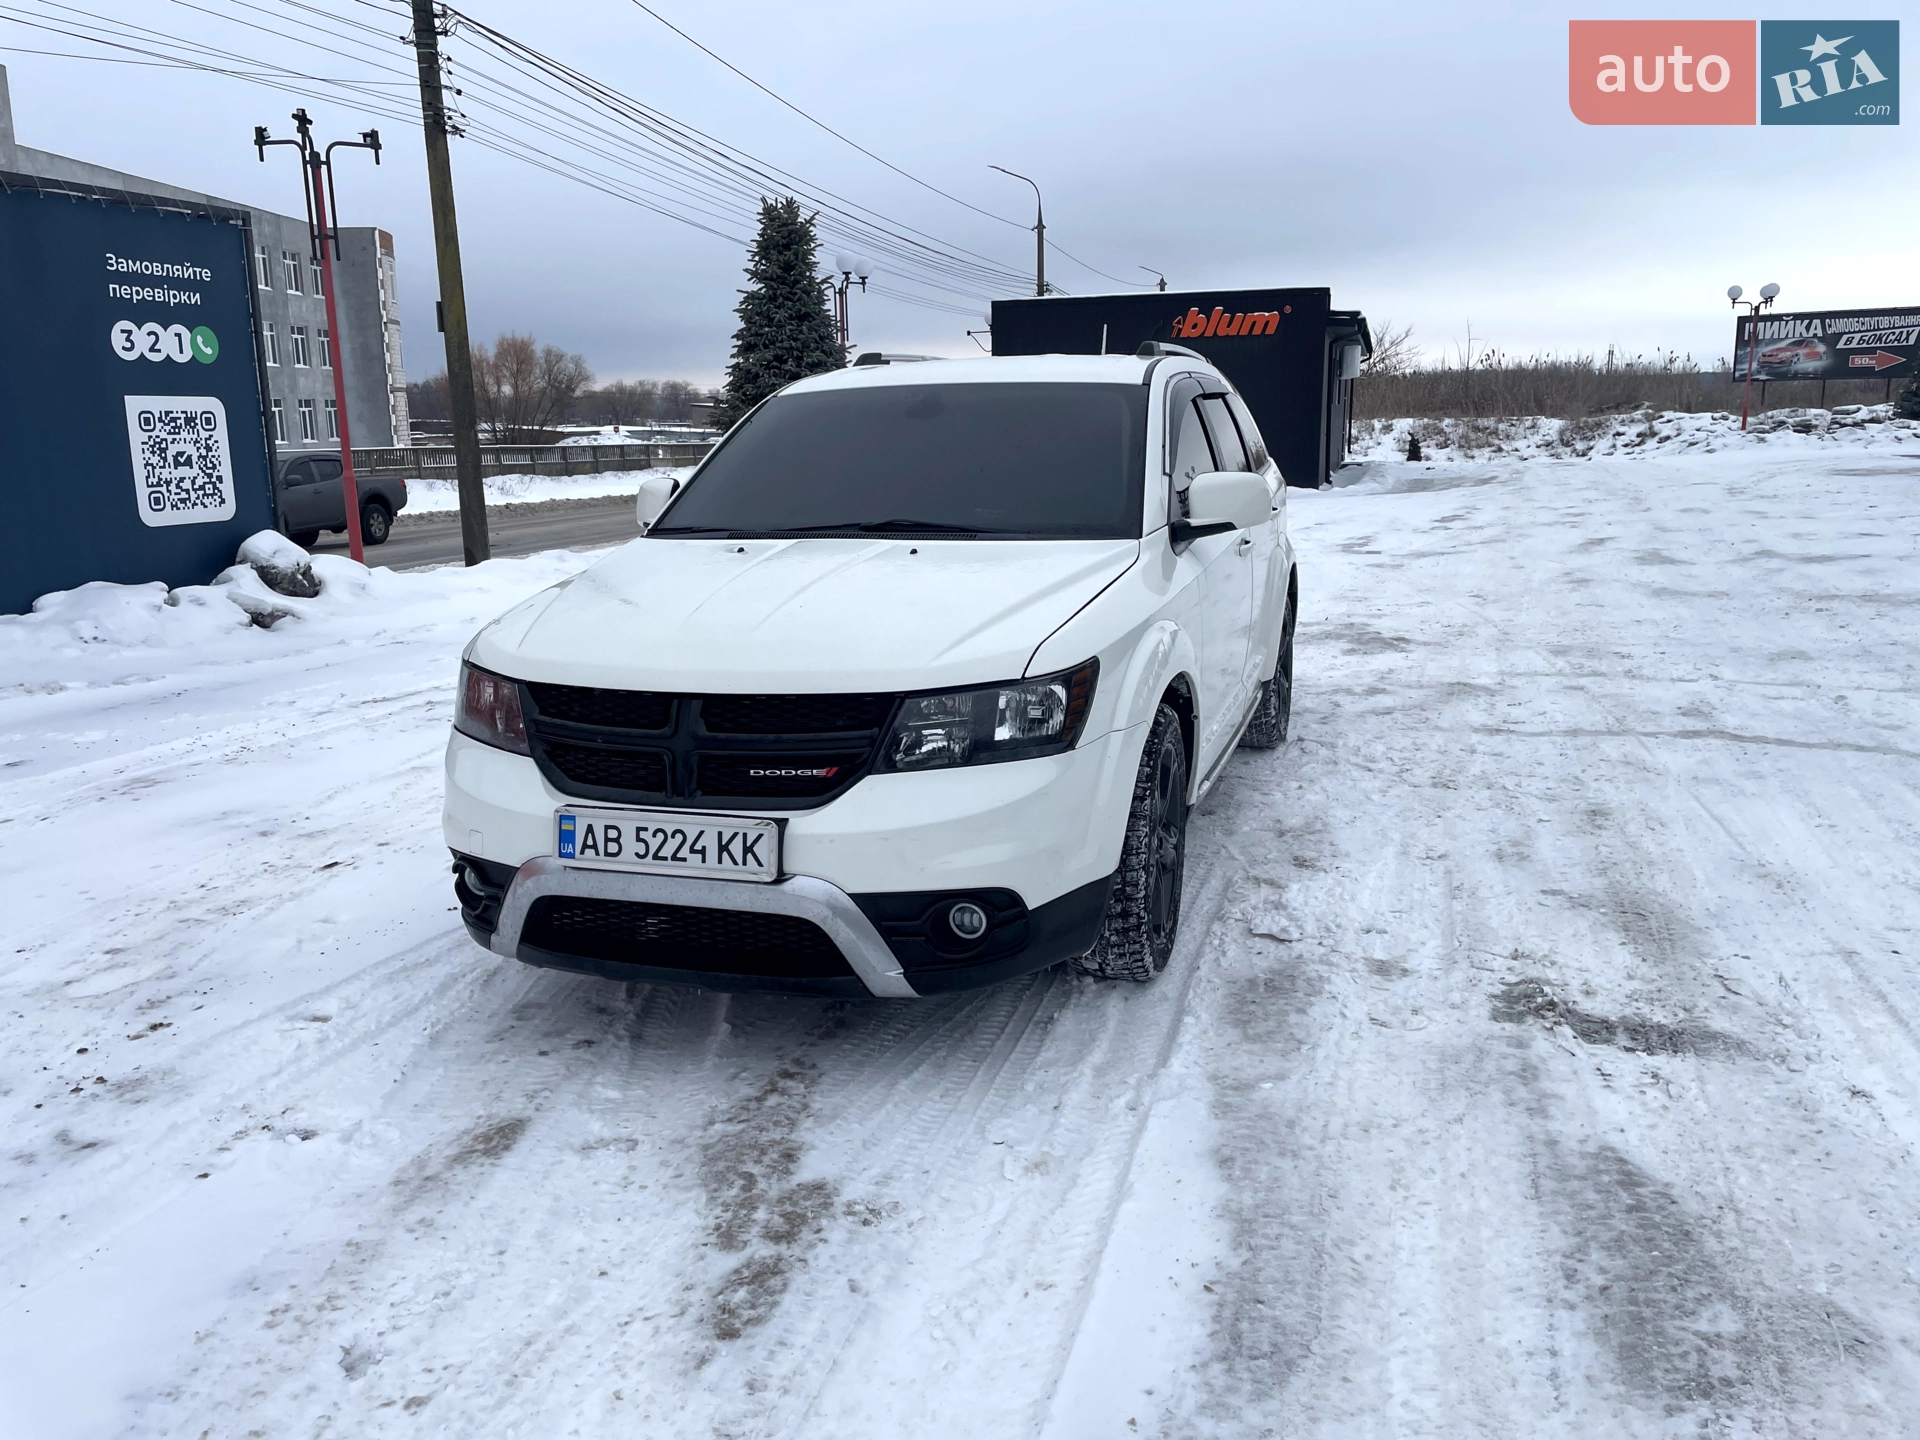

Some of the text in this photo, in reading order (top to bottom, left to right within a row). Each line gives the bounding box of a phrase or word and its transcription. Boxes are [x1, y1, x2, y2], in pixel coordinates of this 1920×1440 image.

[106, 253, 211, 281] Замовляйте
[109, 284, 201, 307] перевірки
[1179, 306, 1280, 338] blum
[120, 329, 185, 355] 321
[1856, 330, 1914, 346] БОКСАХ
[749, 768, 828, 778] DODGE
[560, 842, 574, 855] UA
[579, 823, 765, 868] AB 5224 KK
